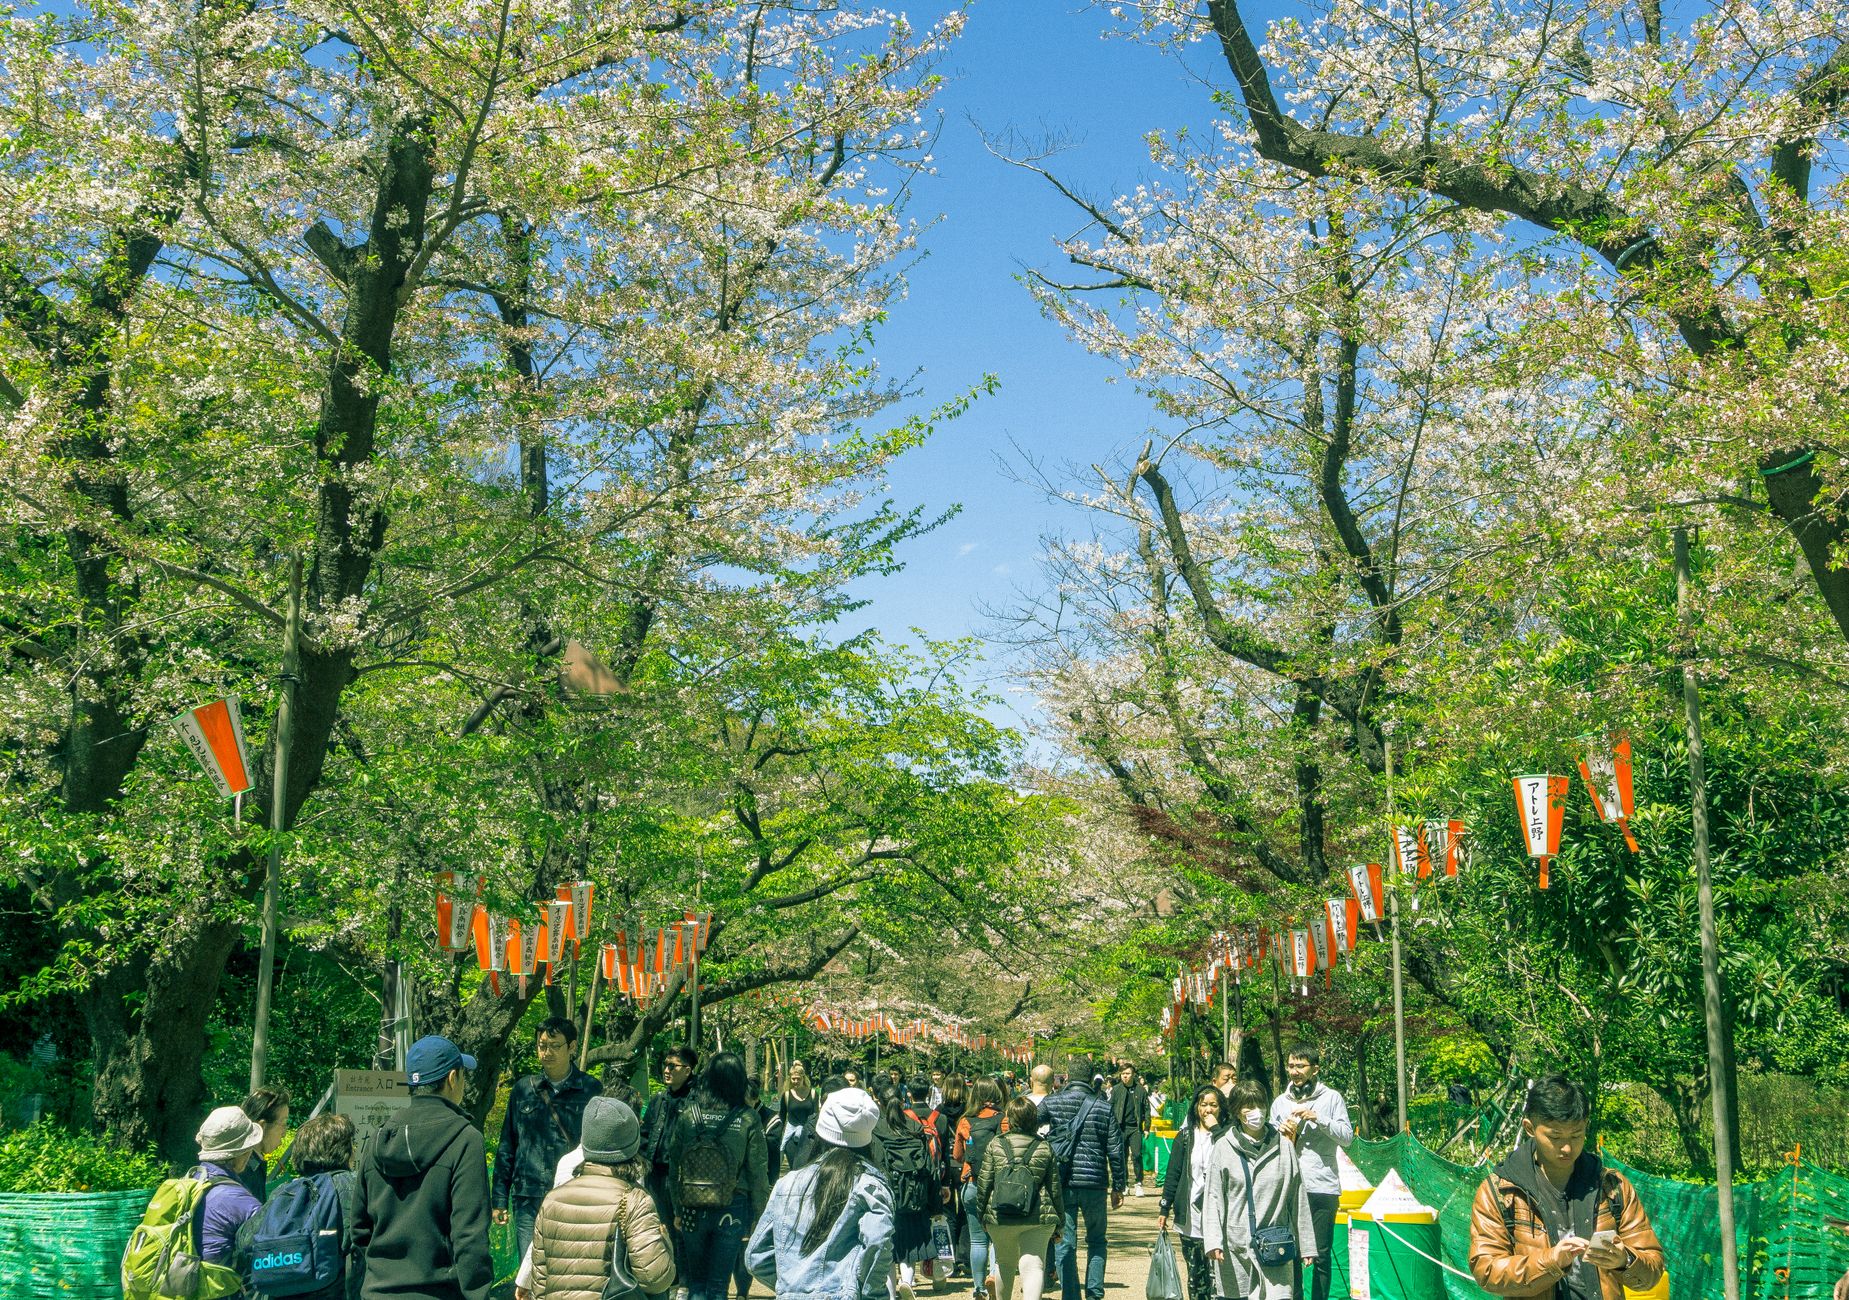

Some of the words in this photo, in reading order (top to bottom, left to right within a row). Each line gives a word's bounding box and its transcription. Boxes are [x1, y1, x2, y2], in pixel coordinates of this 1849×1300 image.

[1527, 782, 1544, 841] アトレ上野
[1355, 871, 1371, 909] アトレ上野
[1332, 903, 1345, 941] アトレ上野
[1296, 934, 1306, 969] アトレ上野
[1314, 924, 1326, 958] アトレ上野
[346, 1083, 373, 1092] Entrance
[376, 1078, 394, 1090] 入口
[253, 1252, 303, 1270] adidas
